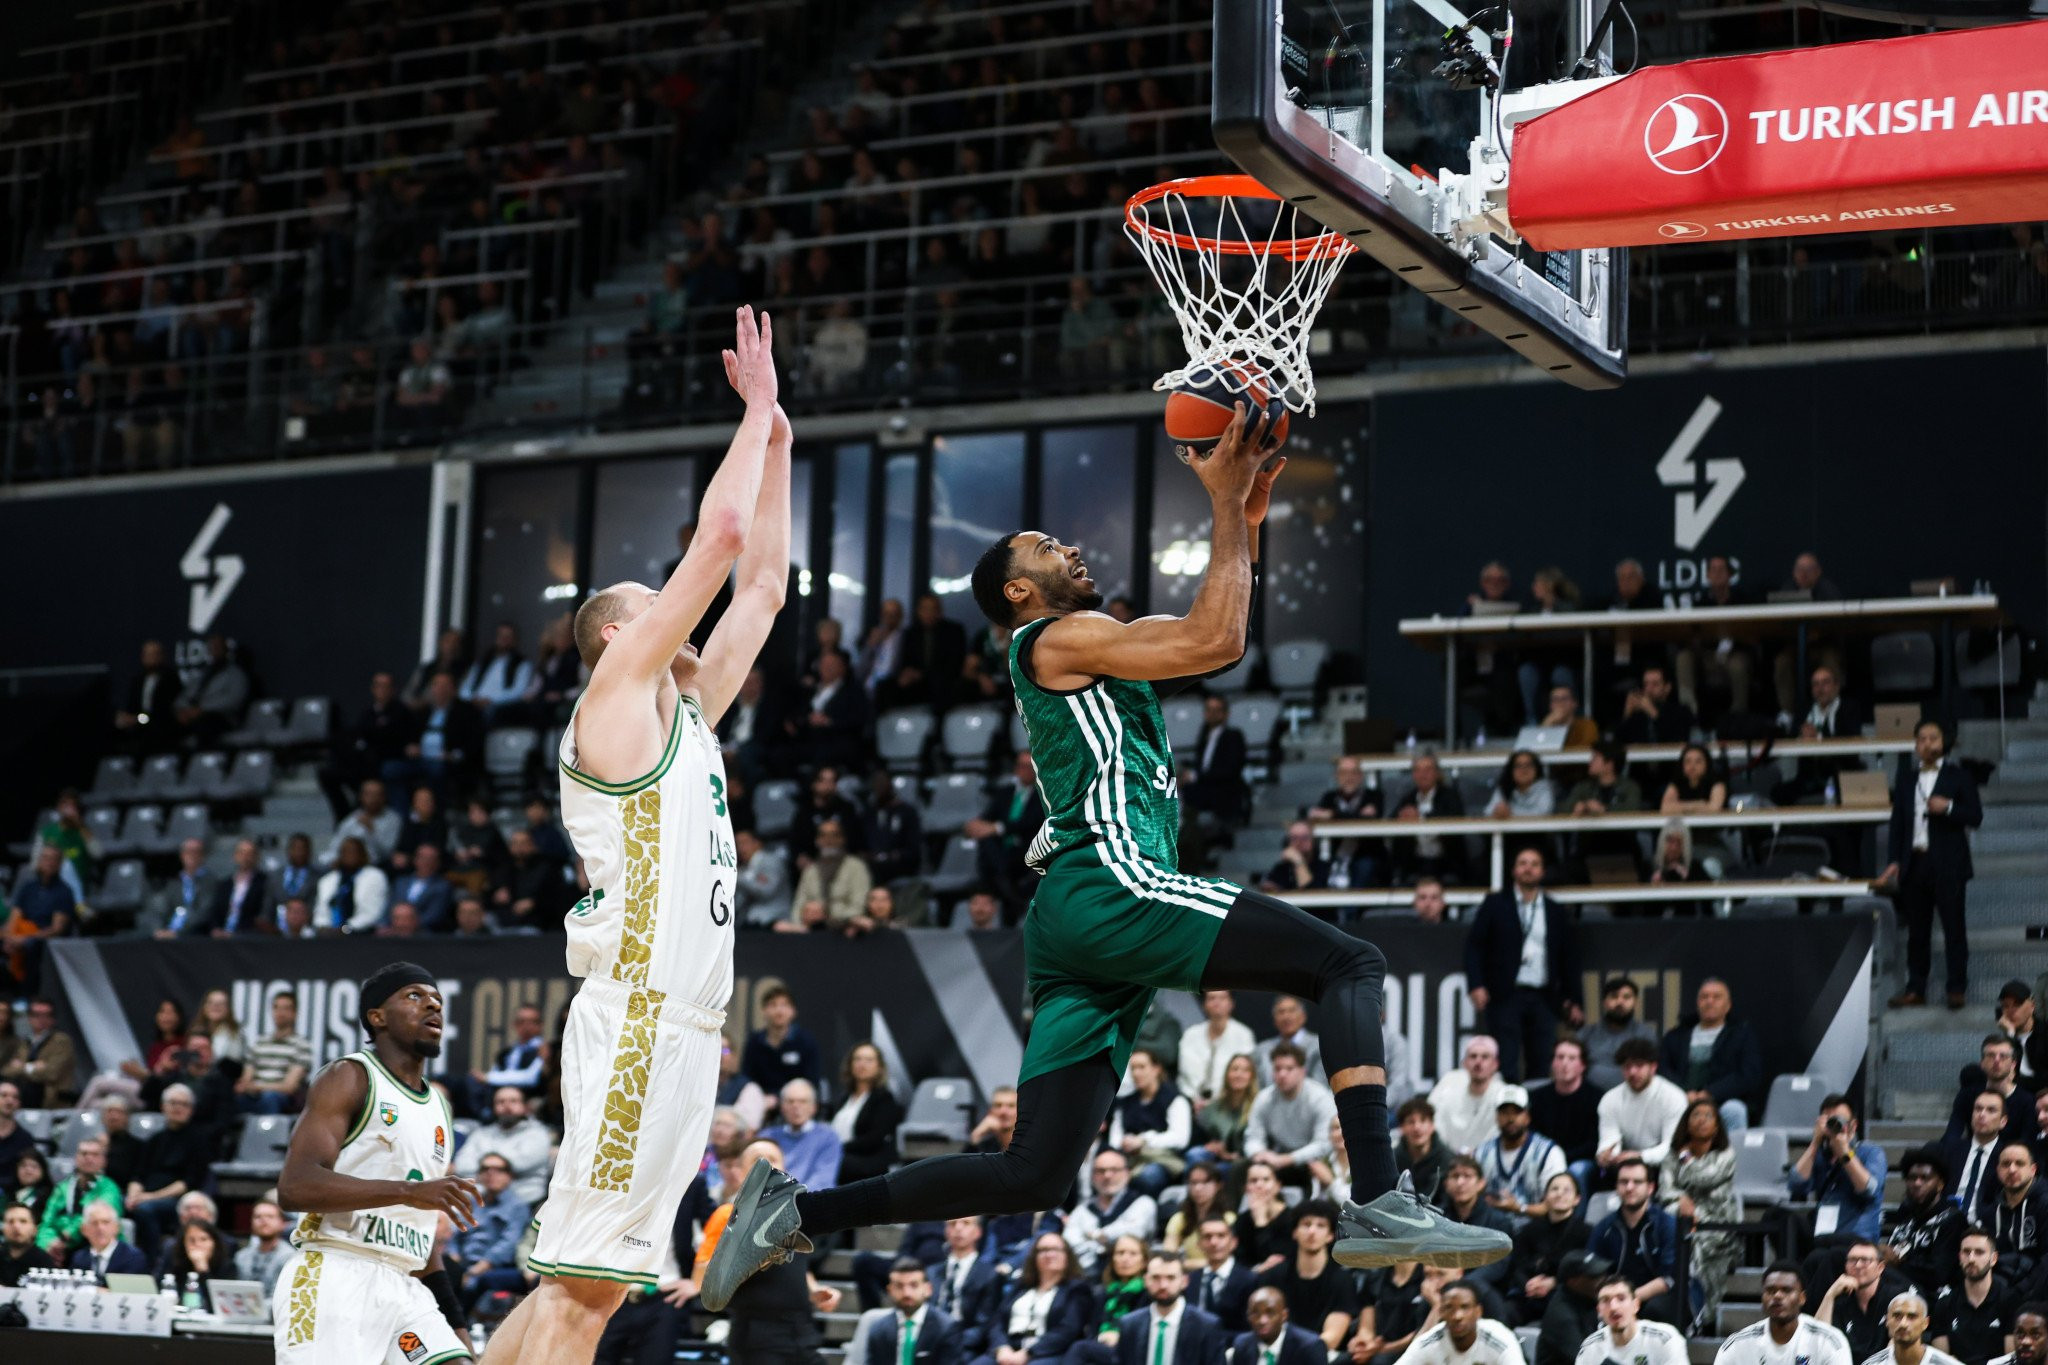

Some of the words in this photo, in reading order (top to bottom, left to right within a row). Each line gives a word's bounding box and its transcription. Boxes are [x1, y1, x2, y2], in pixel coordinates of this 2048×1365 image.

[1749, 97, 1955, 144] TURKISH
[1968, 89, 2048, 128] AIR
[1715, 213, 1831, 231] TURKISH
[1839, 203, 1956, 222] AIRLINES
